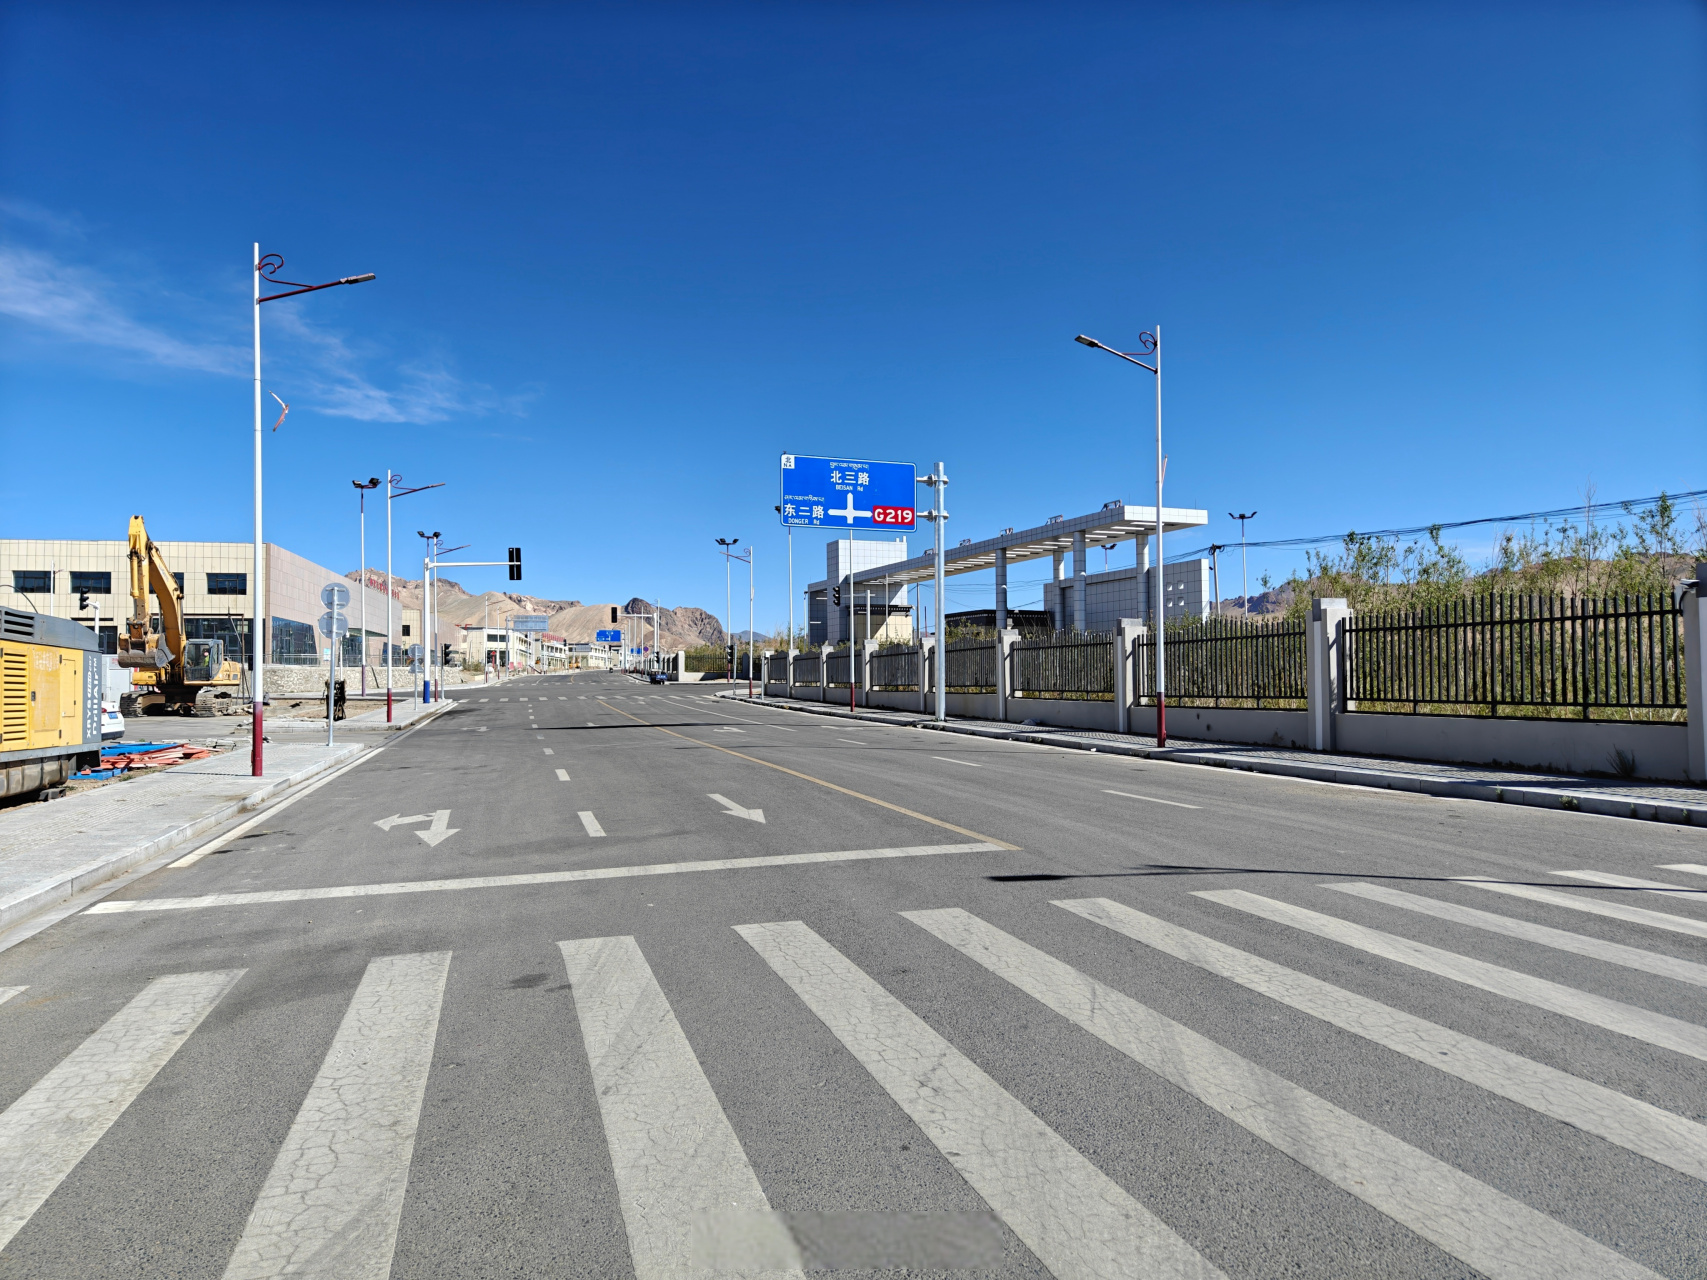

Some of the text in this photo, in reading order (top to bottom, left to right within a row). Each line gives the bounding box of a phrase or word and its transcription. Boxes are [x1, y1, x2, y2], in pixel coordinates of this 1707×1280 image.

[830, 470, 870, 485] 北三路
[784, 504, 824, 518] 东二路
[874, 508, 912, 522] G219
